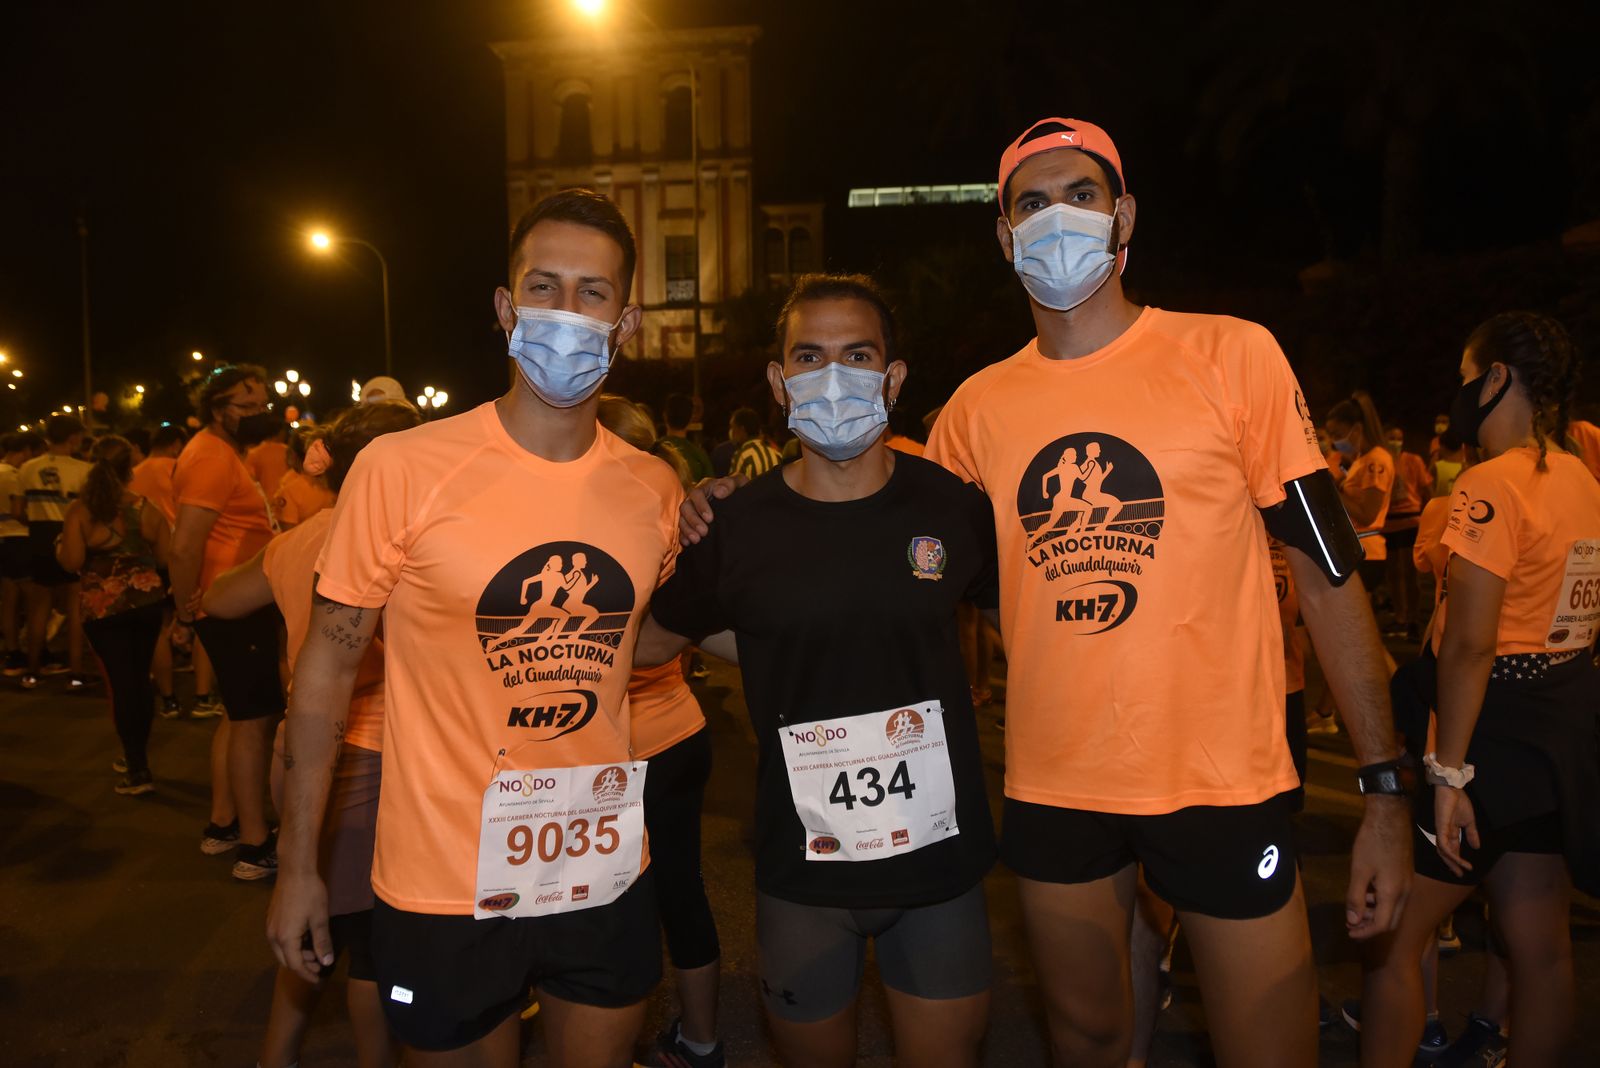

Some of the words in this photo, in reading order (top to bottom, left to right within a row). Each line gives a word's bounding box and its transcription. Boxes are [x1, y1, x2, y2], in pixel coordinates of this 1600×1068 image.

[1028, 548, 1050, 568] LA
[1051, 535, 1155, 560] NOCTURNA
[1045, 565, 1061, 582] del
[1061, 555, 1143, 577] Guadalquivir
[487, 653, 514, 672] LA
[518, 643, 615, 668] NOCTURNA
[503, 670, 523, 688] del
[525, 664, 602, 686] Guadalquivir
[809, 762, 833, 771] CARRERA
[834, 757, 866, 768] NOCTURNA
[866, 755, 877, 763] DEL
[878, 746, 919, 761] GUADALQUIVIR
[931, 740, 944, 749] 2021
[829, 760, 916, 810] 434
[506, 813, 533, 822] CARRERA
[534, 810, 567, 819] NOCTURNA
[567, 809, 578, 817] DEL
[578, 804, 618, 815] GUADALQUIVIR
[628, 800, 641, 808] 2021
[506, 814, 620, 865] 9035
